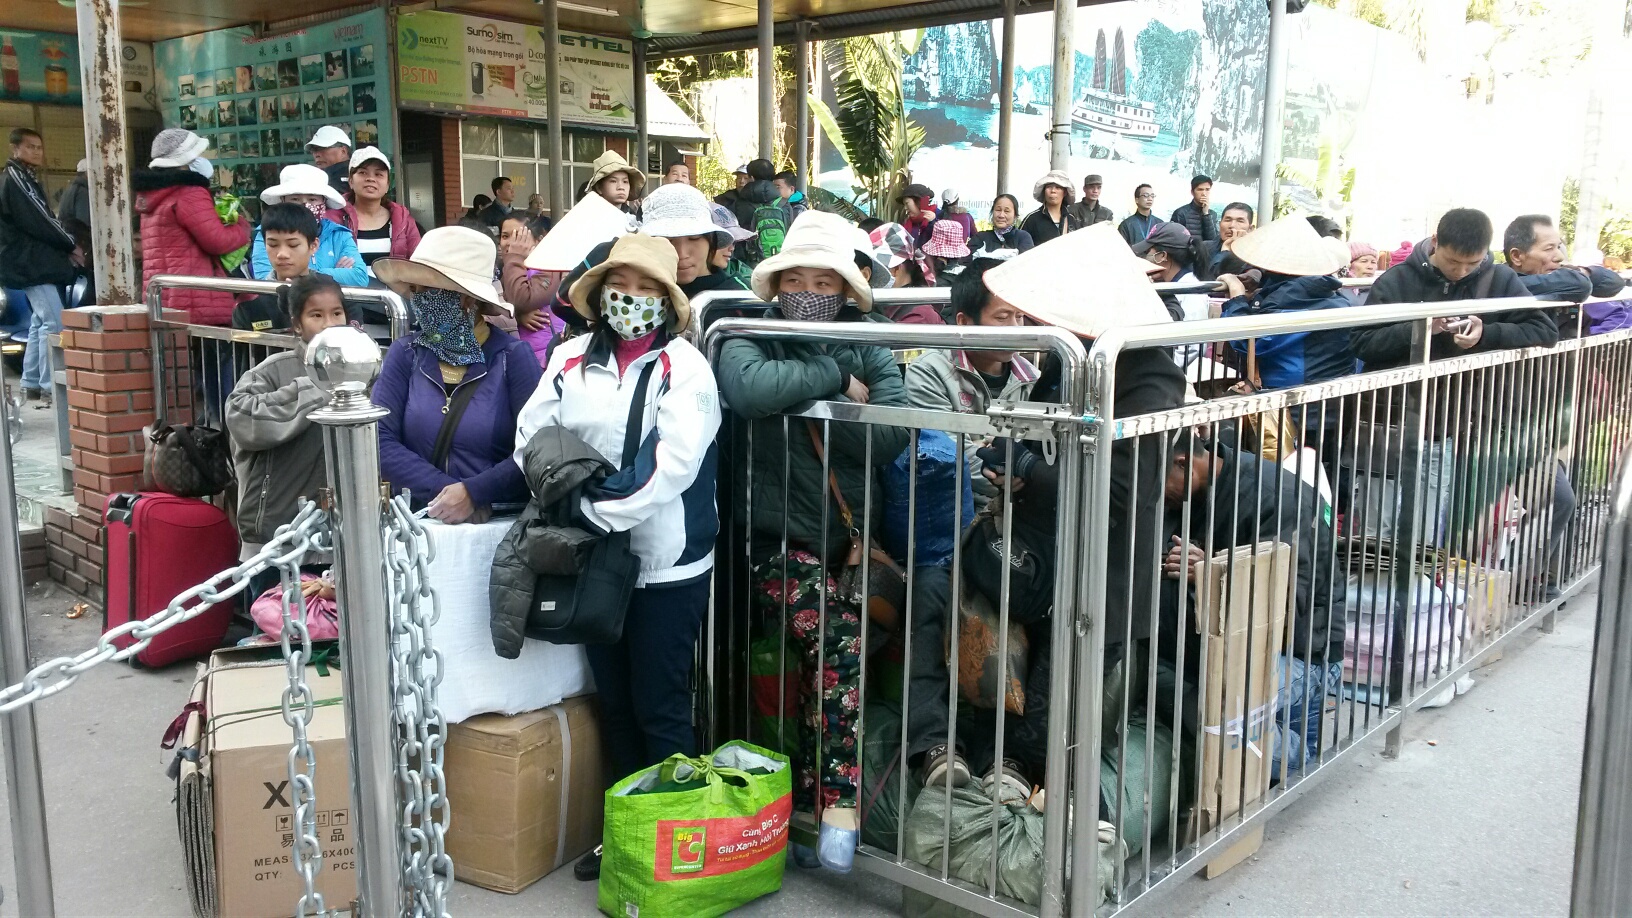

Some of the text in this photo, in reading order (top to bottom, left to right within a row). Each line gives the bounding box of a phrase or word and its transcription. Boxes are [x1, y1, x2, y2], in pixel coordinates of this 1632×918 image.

[420, 35, 448, 46] nextTV
[466, 26, 513, 41] Sumo sim
[538, 31, 630, 54] ETTEL
[401, 65, 438, 85] PSTN
[511, 175, 526, 186] WC
[761, 819, 773, 831] Big
[773, 814, 778, 823] C
[281, 828, 345, 849] 易品
[677, 832, 693, 843] Big
[717, 845, 735, 854] Giữ
[736, 839, 758, 852] Xanh
[254, 871, 282, 881] QTY:
